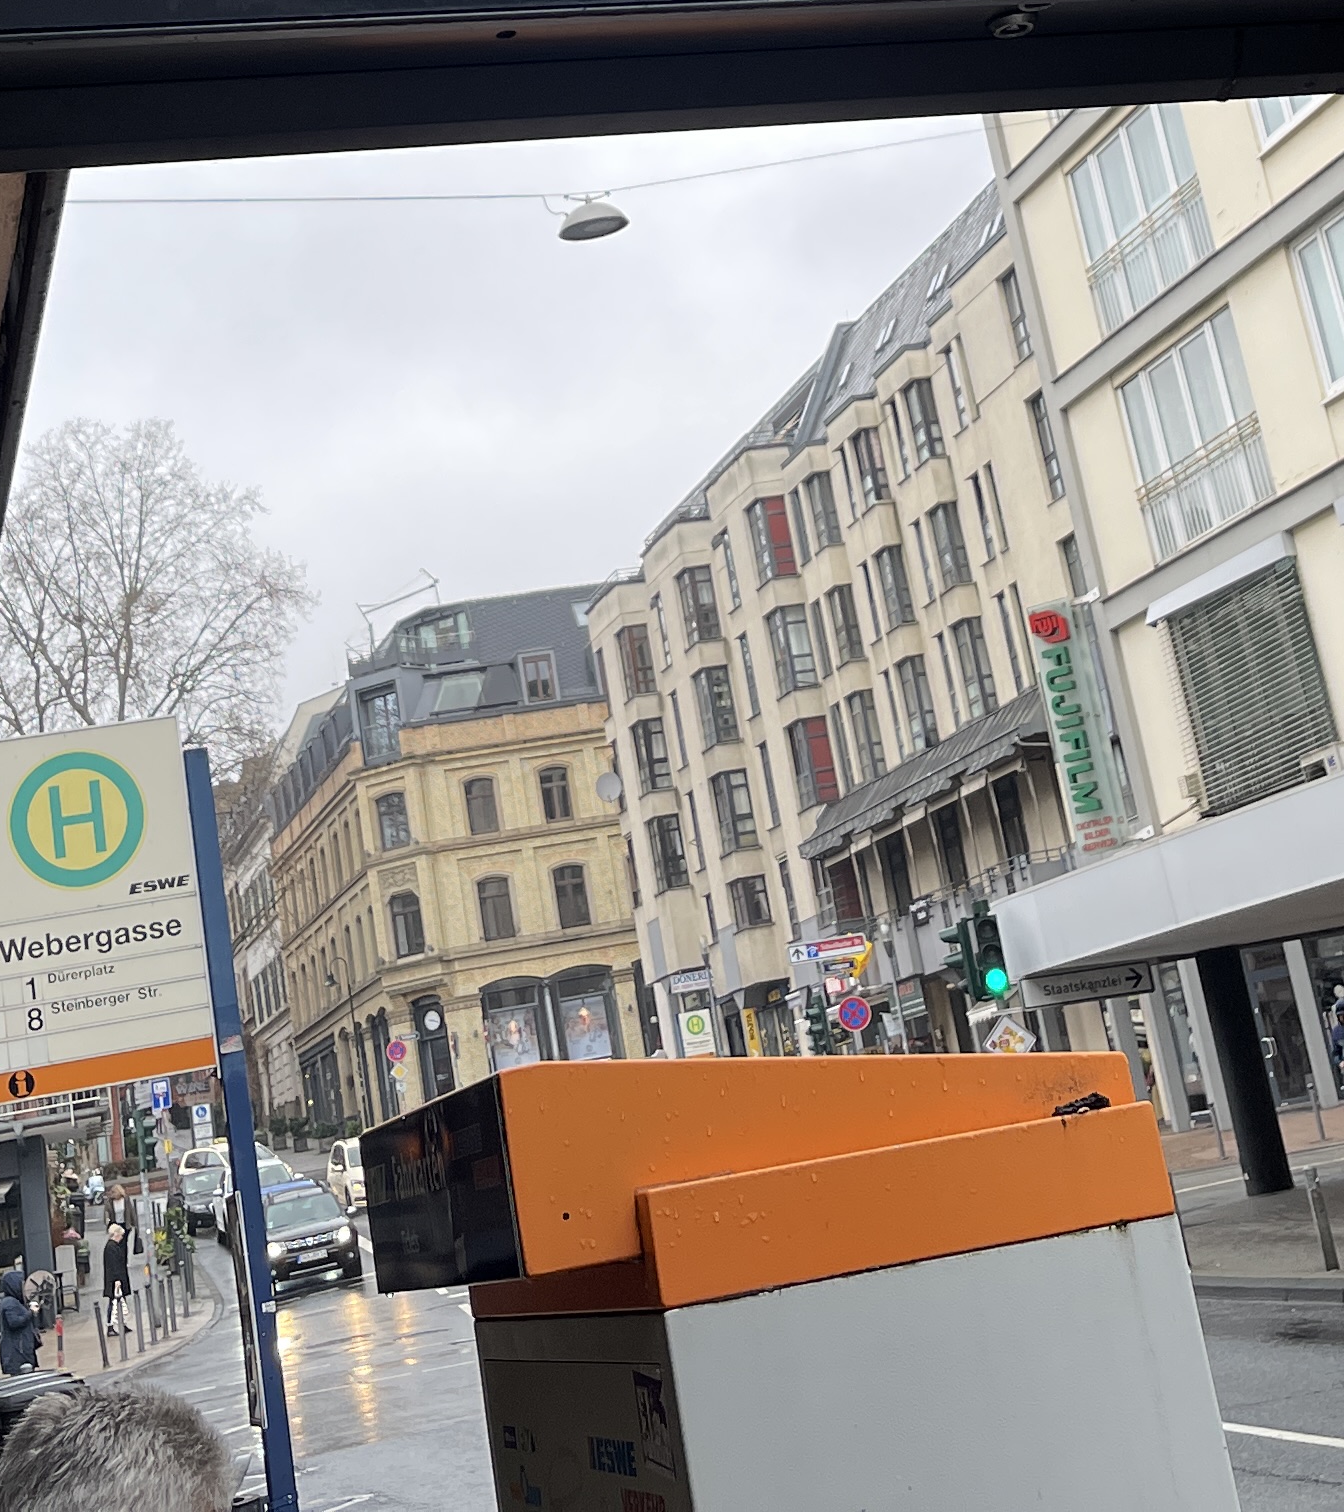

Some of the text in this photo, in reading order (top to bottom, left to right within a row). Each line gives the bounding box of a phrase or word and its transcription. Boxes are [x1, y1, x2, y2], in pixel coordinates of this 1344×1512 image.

[1041, 645, 1103, 814] FUJIFILM
[48, 779, 107, 859] H
[128, 874, 190, 895] ESWE
[26, 963, 116, 1000] 1 Dürerplatz
[1043, 976, 1122, 996] Staatskanzlei
[27, 985, 163, 1031] 8 Steinberger Str.
